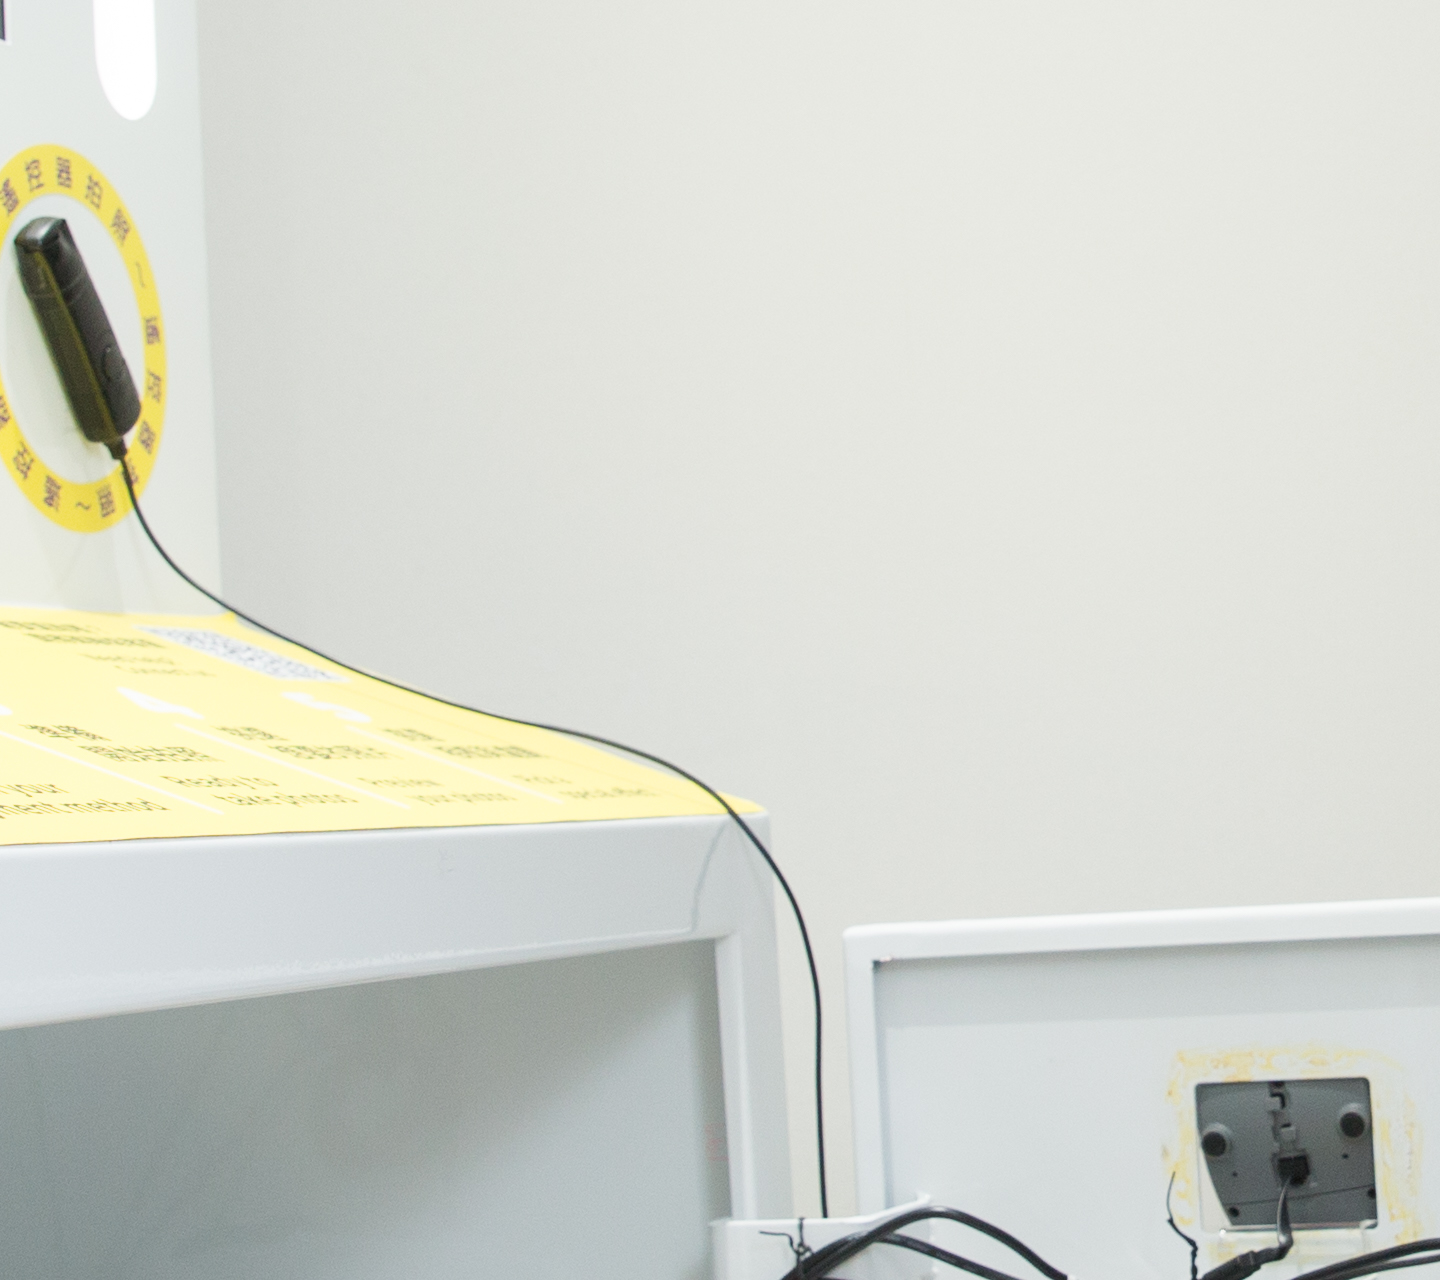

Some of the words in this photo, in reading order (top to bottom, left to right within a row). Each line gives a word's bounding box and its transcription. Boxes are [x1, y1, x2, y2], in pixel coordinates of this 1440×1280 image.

[161, 774, 248, 789] Ready
[242, 776, 279, 787] to
[59, 797, 170, 813] method
[212, 793, 278, 807] take
[271, 792, 359, 807] photos
